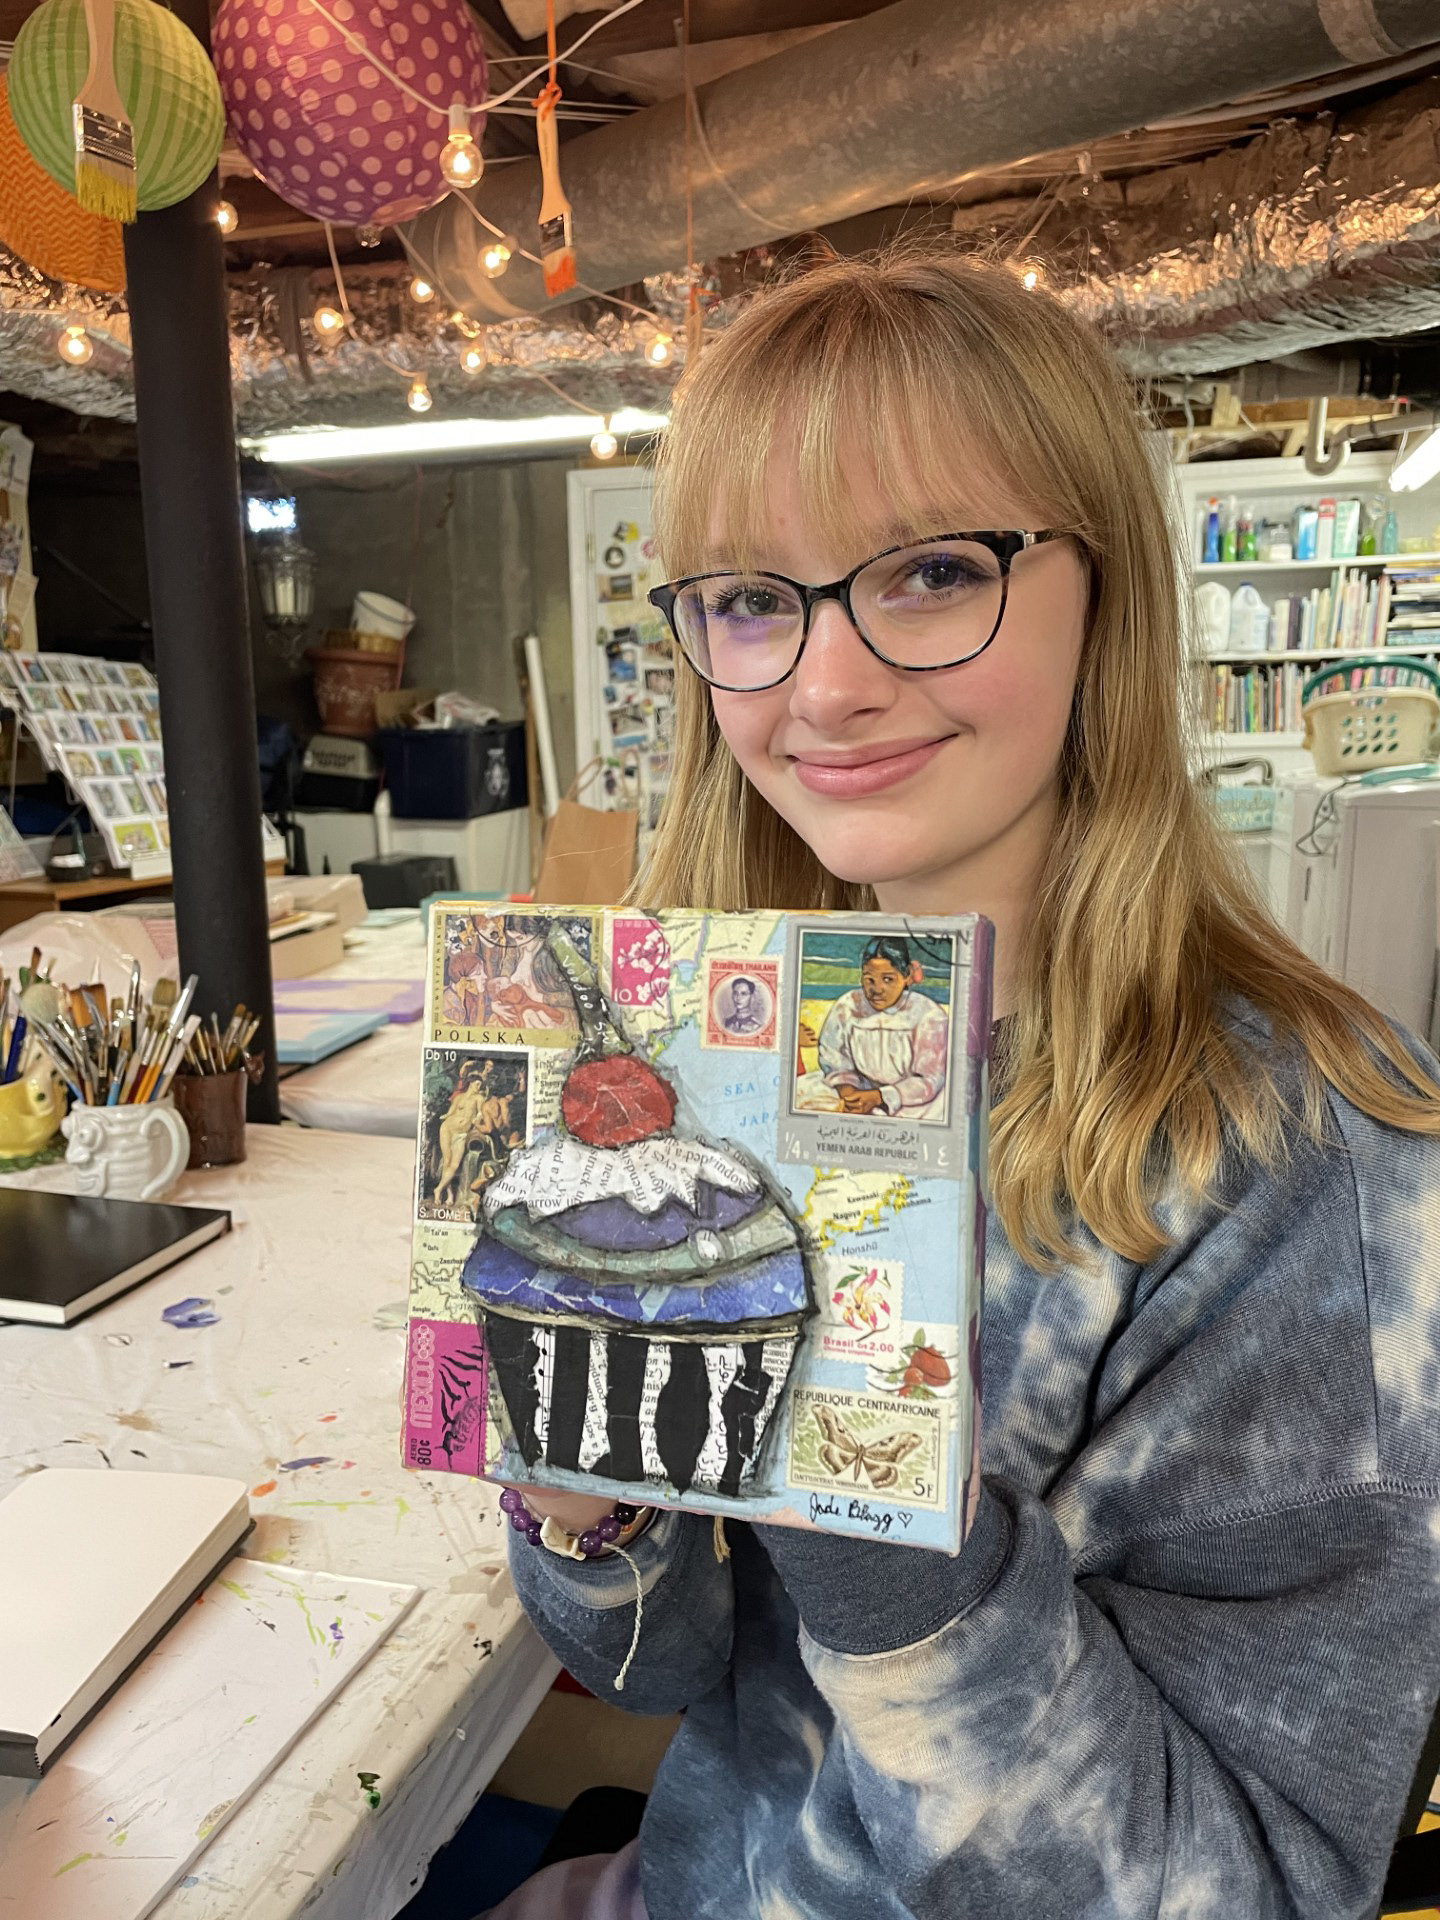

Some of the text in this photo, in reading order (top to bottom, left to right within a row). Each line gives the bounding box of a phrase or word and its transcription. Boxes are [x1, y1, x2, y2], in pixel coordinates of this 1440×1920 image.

[613, 987, 632, 1003] 10
[434, 1029, 525, 1044] POLSKA
[425, 1049, 457, 1062] Db 10
[724, 1083, 756, 1097] SEA
[816, 1142, 919, 1160] YEMEN ARAB REPUBLIC
[580, 1148, 598, 1188] struck
[600, 1163, 613, 1188] new
[847, 1192, 879, 1204] Kawasaki
[832, 1209, 861, 1221] Nagoya
[823, 1335, 854, 1348] Brasil
[869, 1341, 895, 1354] 2.00
[793, 1389, 941, 1419] REPUBLIQUE CENTRAFRICAINE
[809, 1492, 842, 1523] Jade
